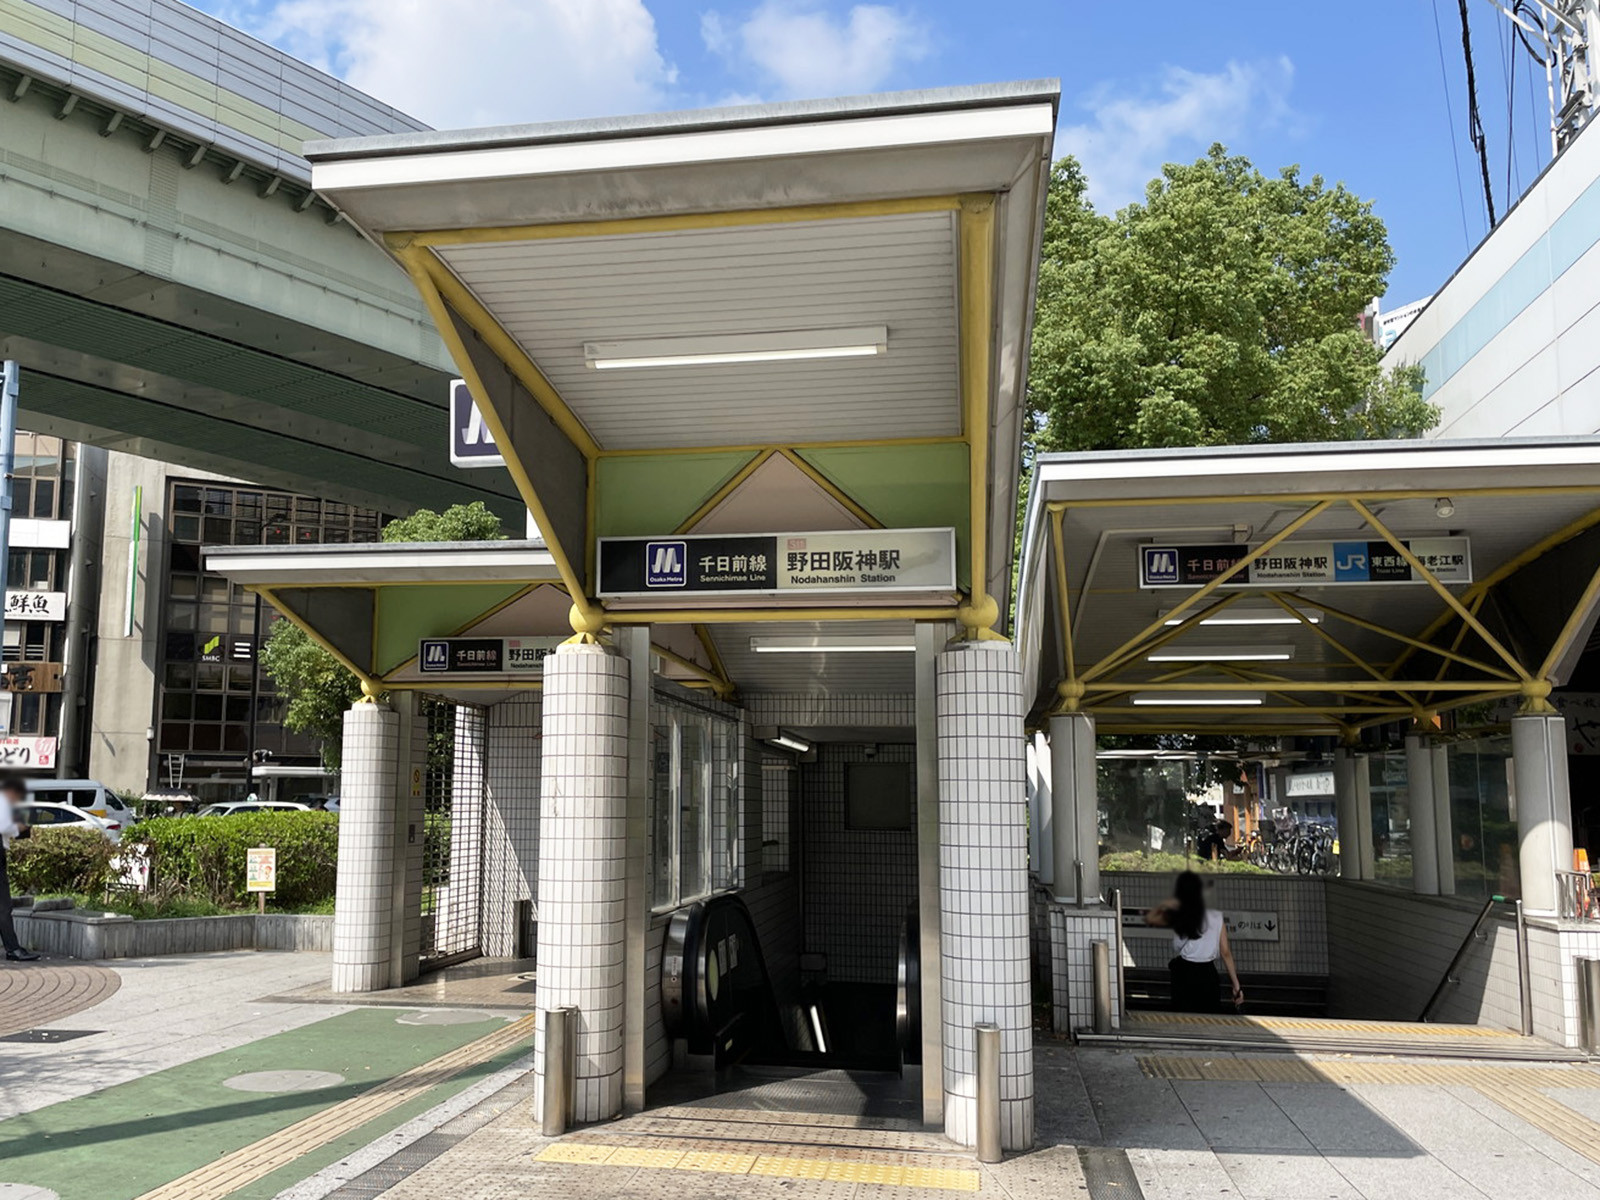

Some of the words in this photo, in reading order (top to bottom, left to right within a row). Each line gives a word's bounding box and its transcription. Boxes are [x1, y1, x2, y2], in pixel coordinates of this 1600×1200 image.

[698, 553, 767, 573] 千日前線
[787, 549, 900, 572] 野田阪神駅
[1254, 556, 1328, 570] 野田阪神駅
[1336, 554, 1366, 571] JR
[700, 574, 747, 583] Sennichimae
[749, 573, 766, 582] Line
[791, 574, 856, 584] Nodahanshin
[860, 573, 896, 583] Station
